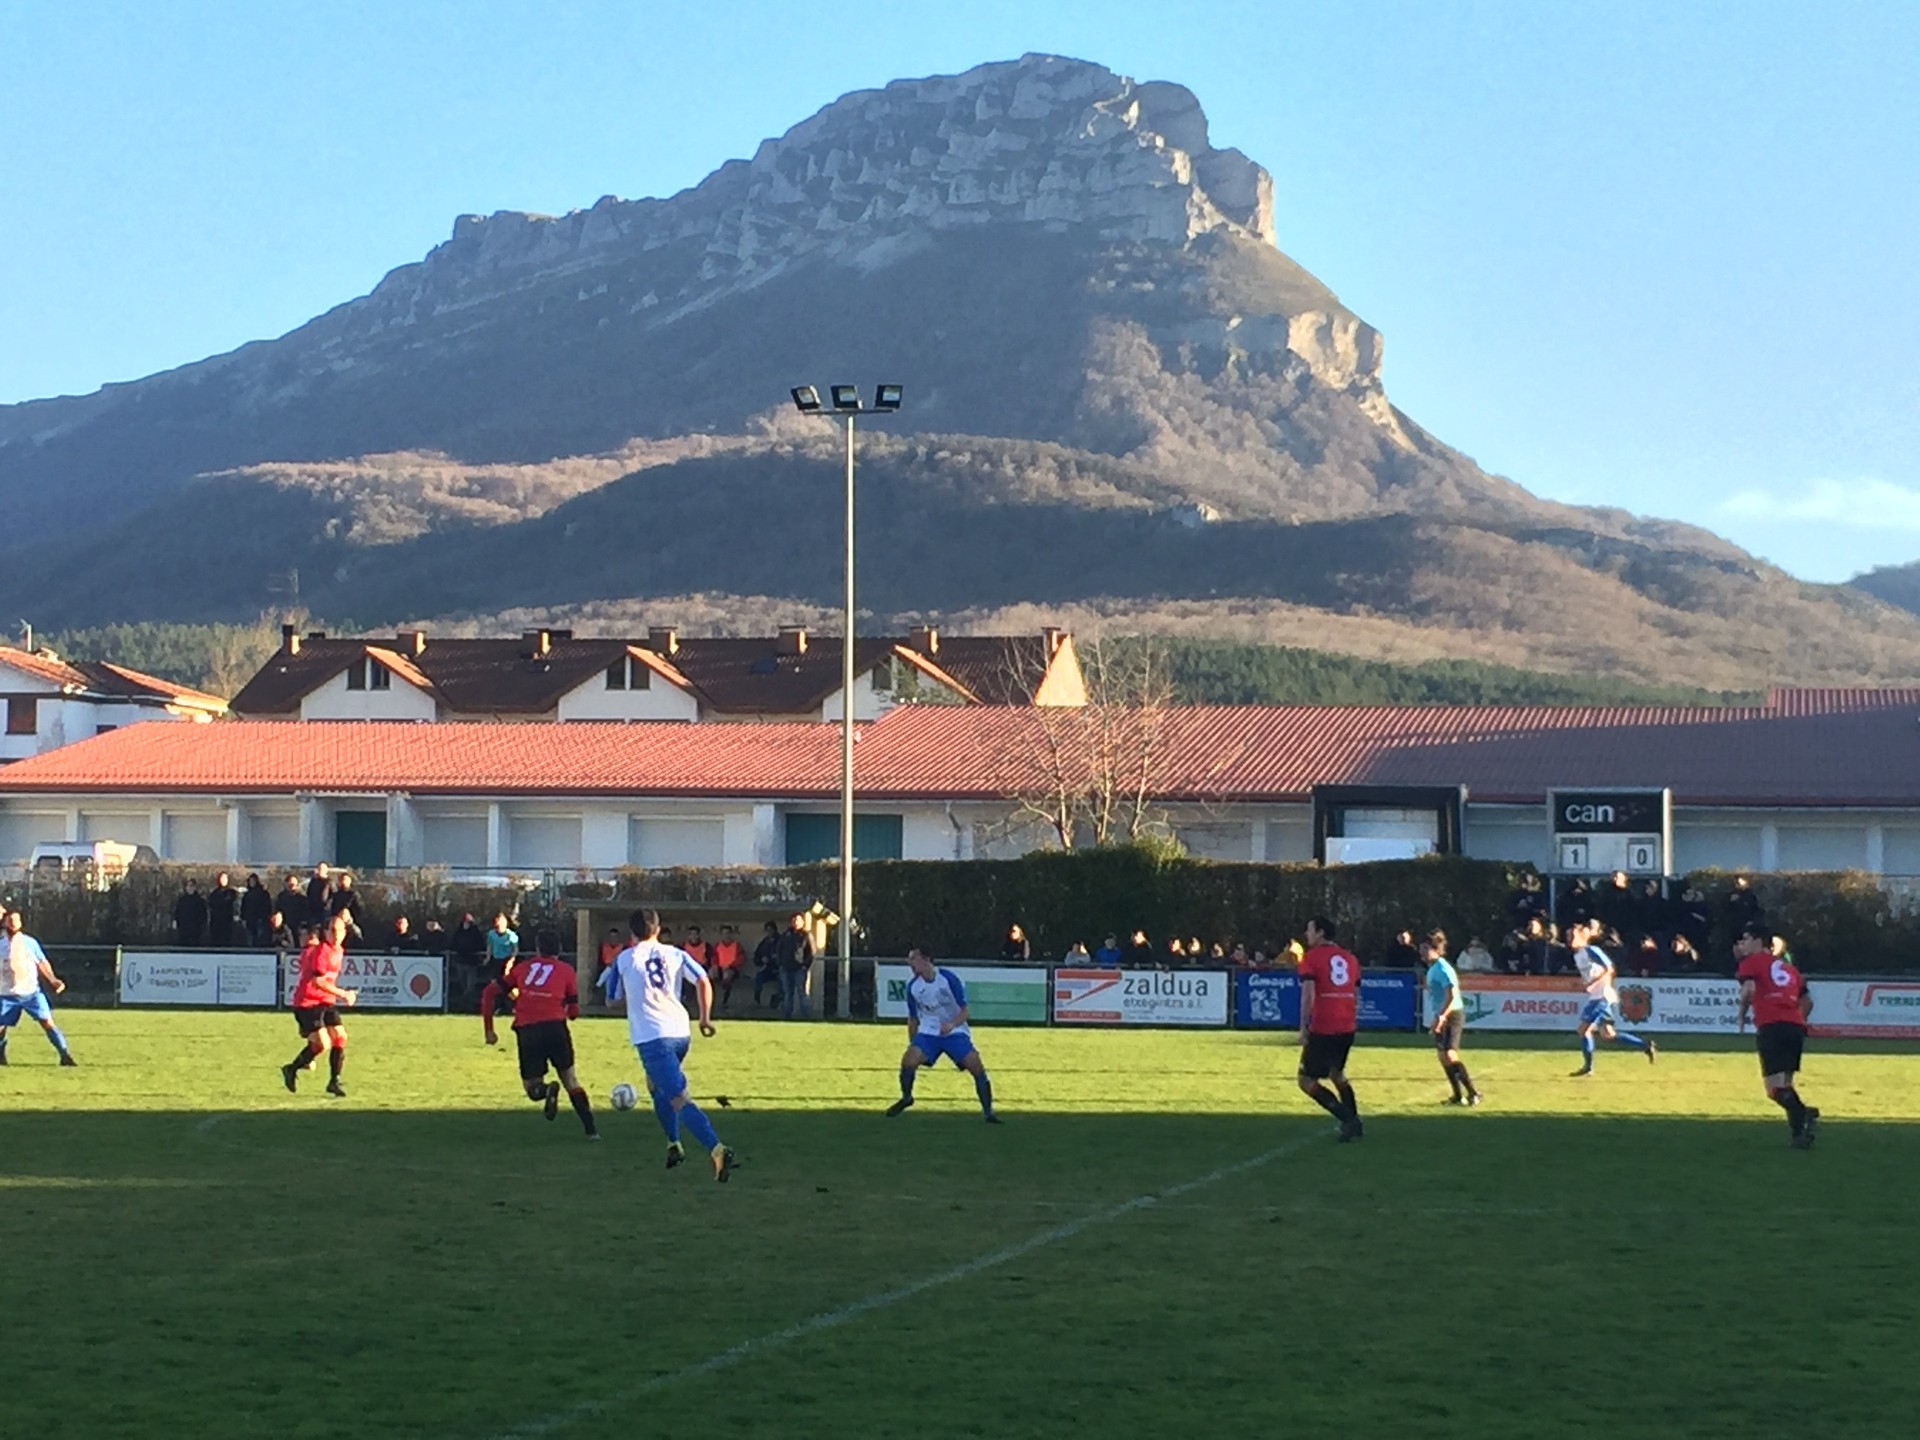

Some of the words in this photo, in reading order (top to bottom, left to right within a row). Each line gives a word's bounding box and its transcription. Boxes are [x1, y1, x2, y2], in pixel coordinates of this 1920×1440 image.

[1565, 804, 1615, 823] can
[1571, 849, 1579, 865] 1
[1637, 848, 1647, 866] 0
[289, 958, 398, 976] SANA
[524, 962, 554, 986] 11
[645, 957, 665, 989] 8
[1330, 955, 1349, 986] 8
[1770, 960, 1793, 987] 6
[1123, 973, 1208, 996] zaldua
[1502, 999, 1579, 1014] ARREGUI
